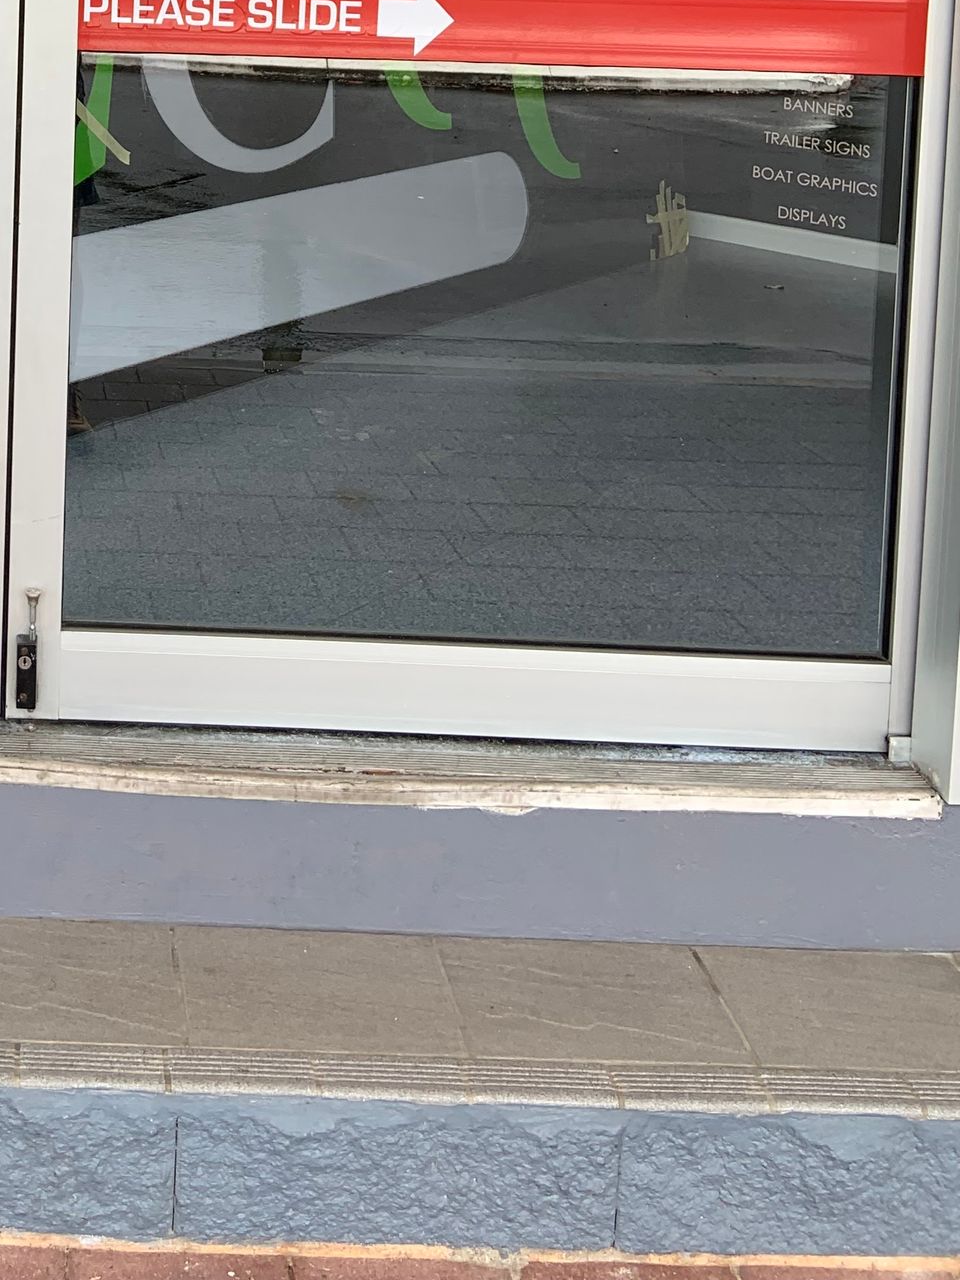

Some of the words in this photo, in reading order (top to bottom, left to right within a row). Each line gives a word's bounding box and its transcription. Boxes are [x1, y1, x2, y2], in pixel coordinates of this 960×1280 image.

[783, 97, 854, 119] BANNERS
[763, 131, 821, 152] TRAILER
[825, 139, 871, 159] SIGNS
[752, 165, 794, 184] BOAT
[797, 172, 878, 198] GRAPHICS
[778, 205, 846, 230] DISPLAYS
